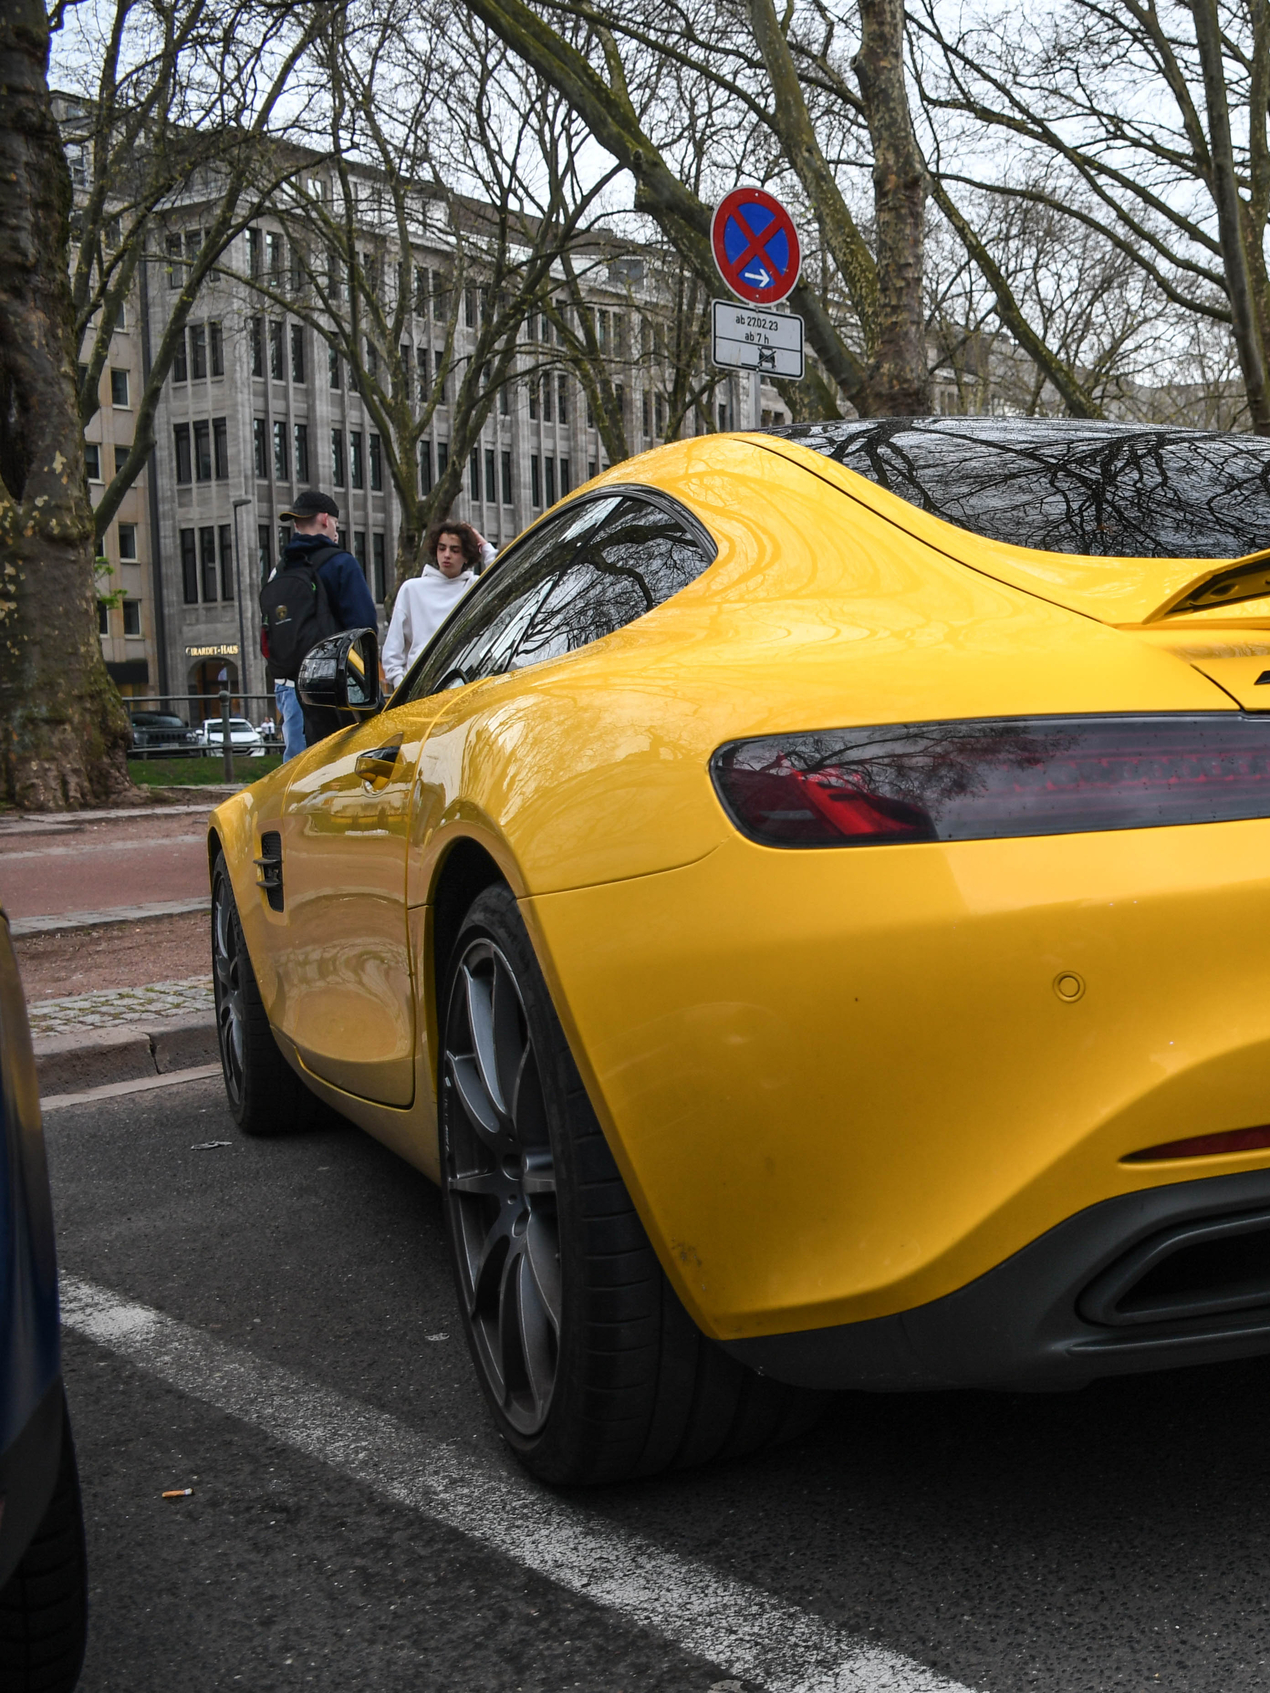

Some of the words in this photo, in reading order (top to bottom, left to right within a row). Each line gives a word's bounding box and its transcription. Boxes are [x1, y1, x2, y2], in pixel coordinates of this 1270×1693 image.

[735, 314, 746, 325] ab
[747, 316, 779, 332] 27.02.23
[744, 331, 755, 342] ab
[756, 332, 762, 343] 7
[764, 334, 770, 345] h
